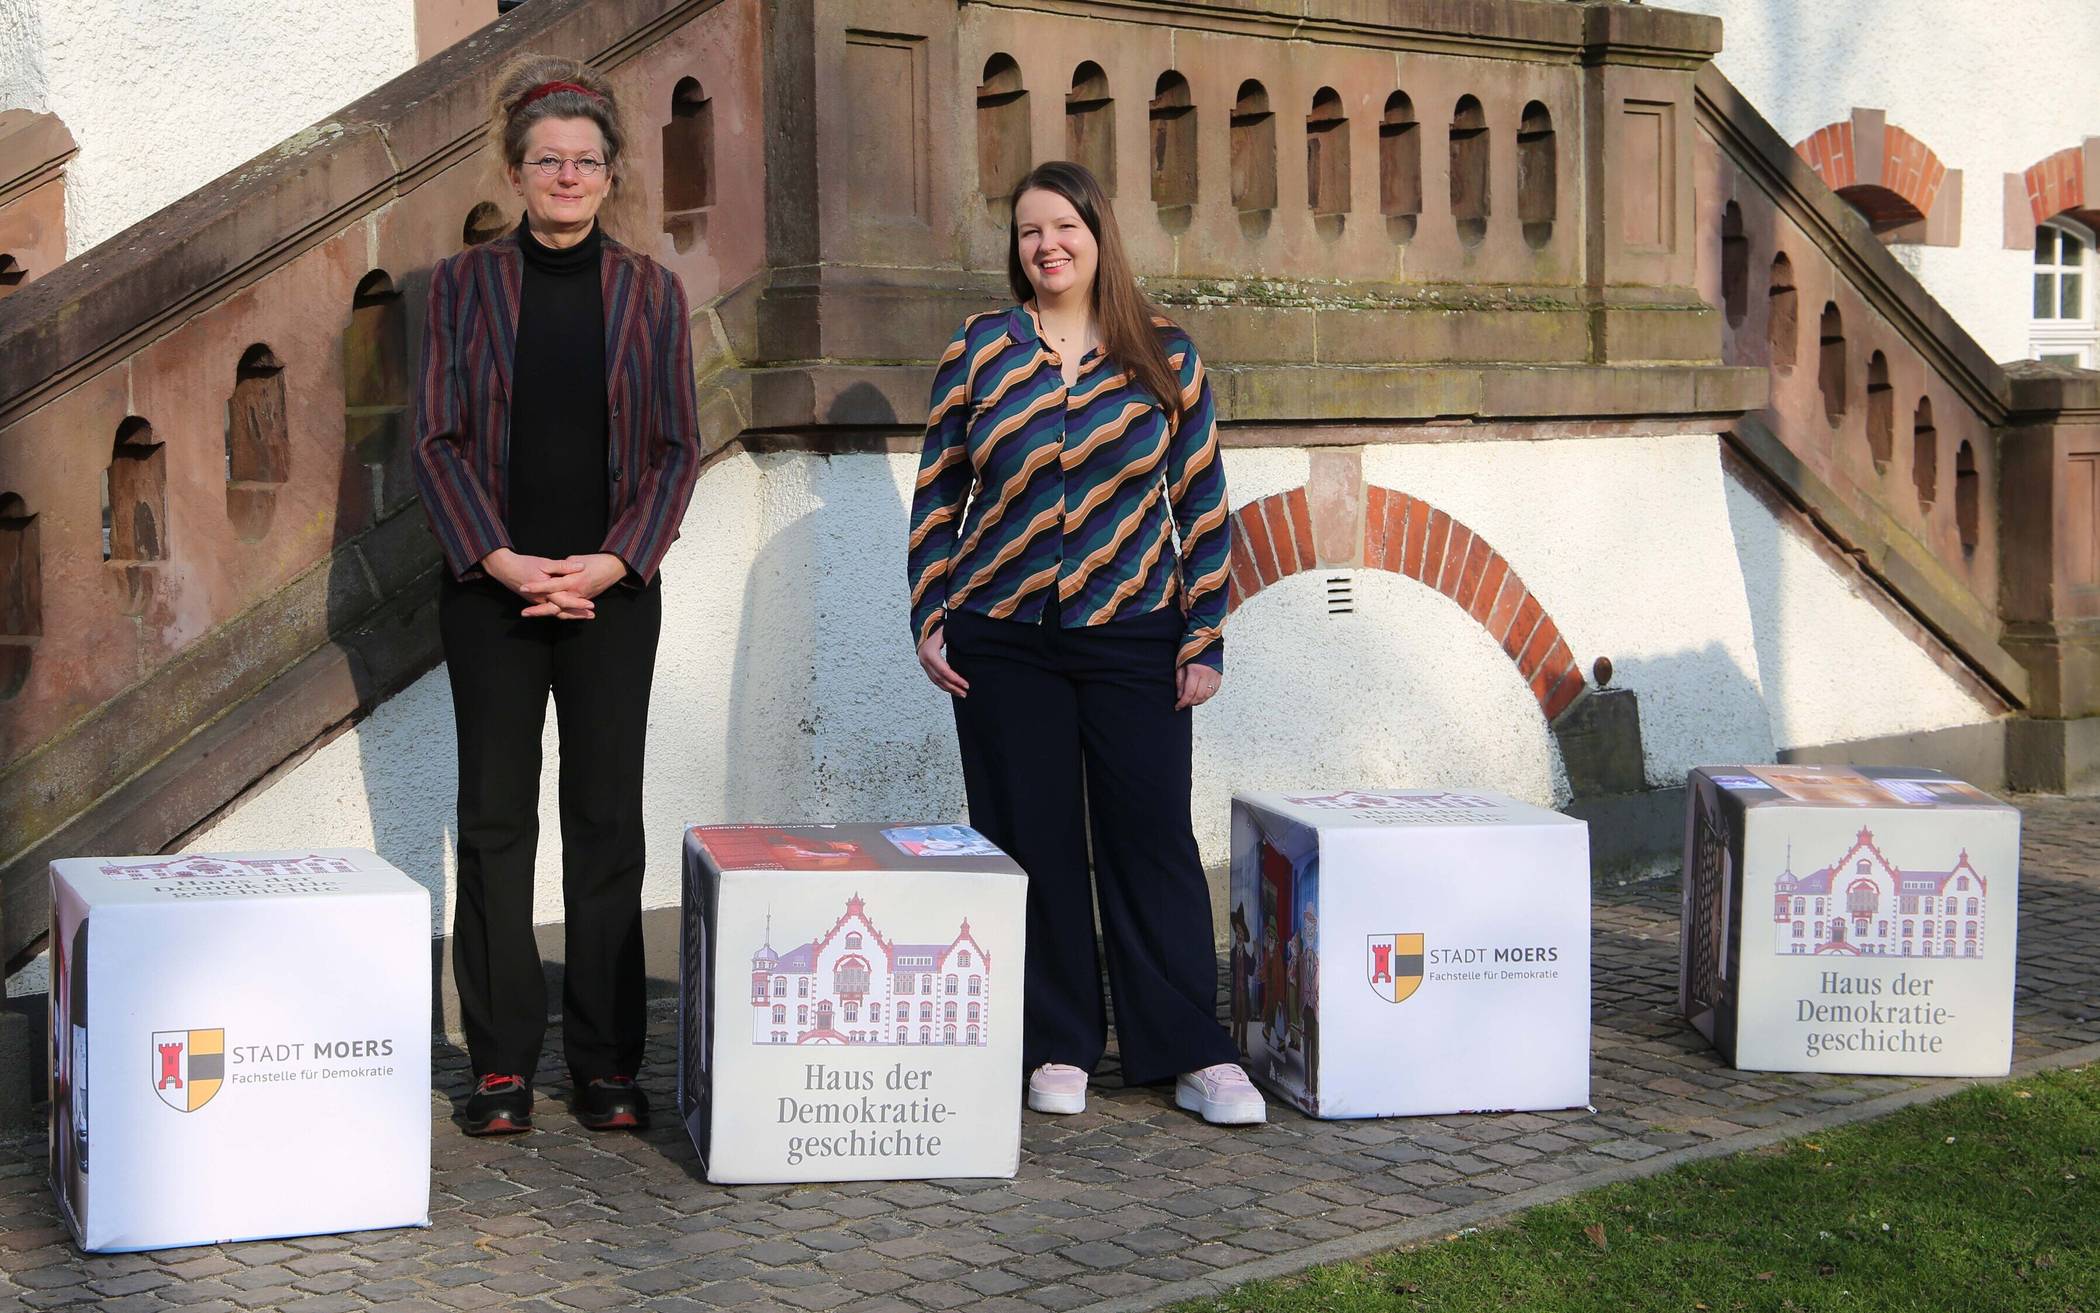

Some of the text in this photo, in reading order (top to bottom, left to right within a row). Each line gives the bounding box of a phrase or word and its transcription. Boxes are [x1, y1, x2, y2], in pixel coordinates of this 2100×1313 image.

[1430, 947, 1558, 964] STADT MOERS
[1429, 969, 1558, 981] Fachstelle für Demokratie
[1820, 971, 1934, 996] Haus der
[1796, 999, 1956, 1025] Demokratie-
[232, 1039, 393, 1064] STADT MOERS
[1806, 1028, 1943, 1057] geschichte
[232, 1065, 394, 1084] Fachstelle für Demokratie
[804, 1063, 932, 1091] Haus der
[777, 1097, 956, 1124] Demokratie-
[788, 1130, 941, 1165] geschichte
